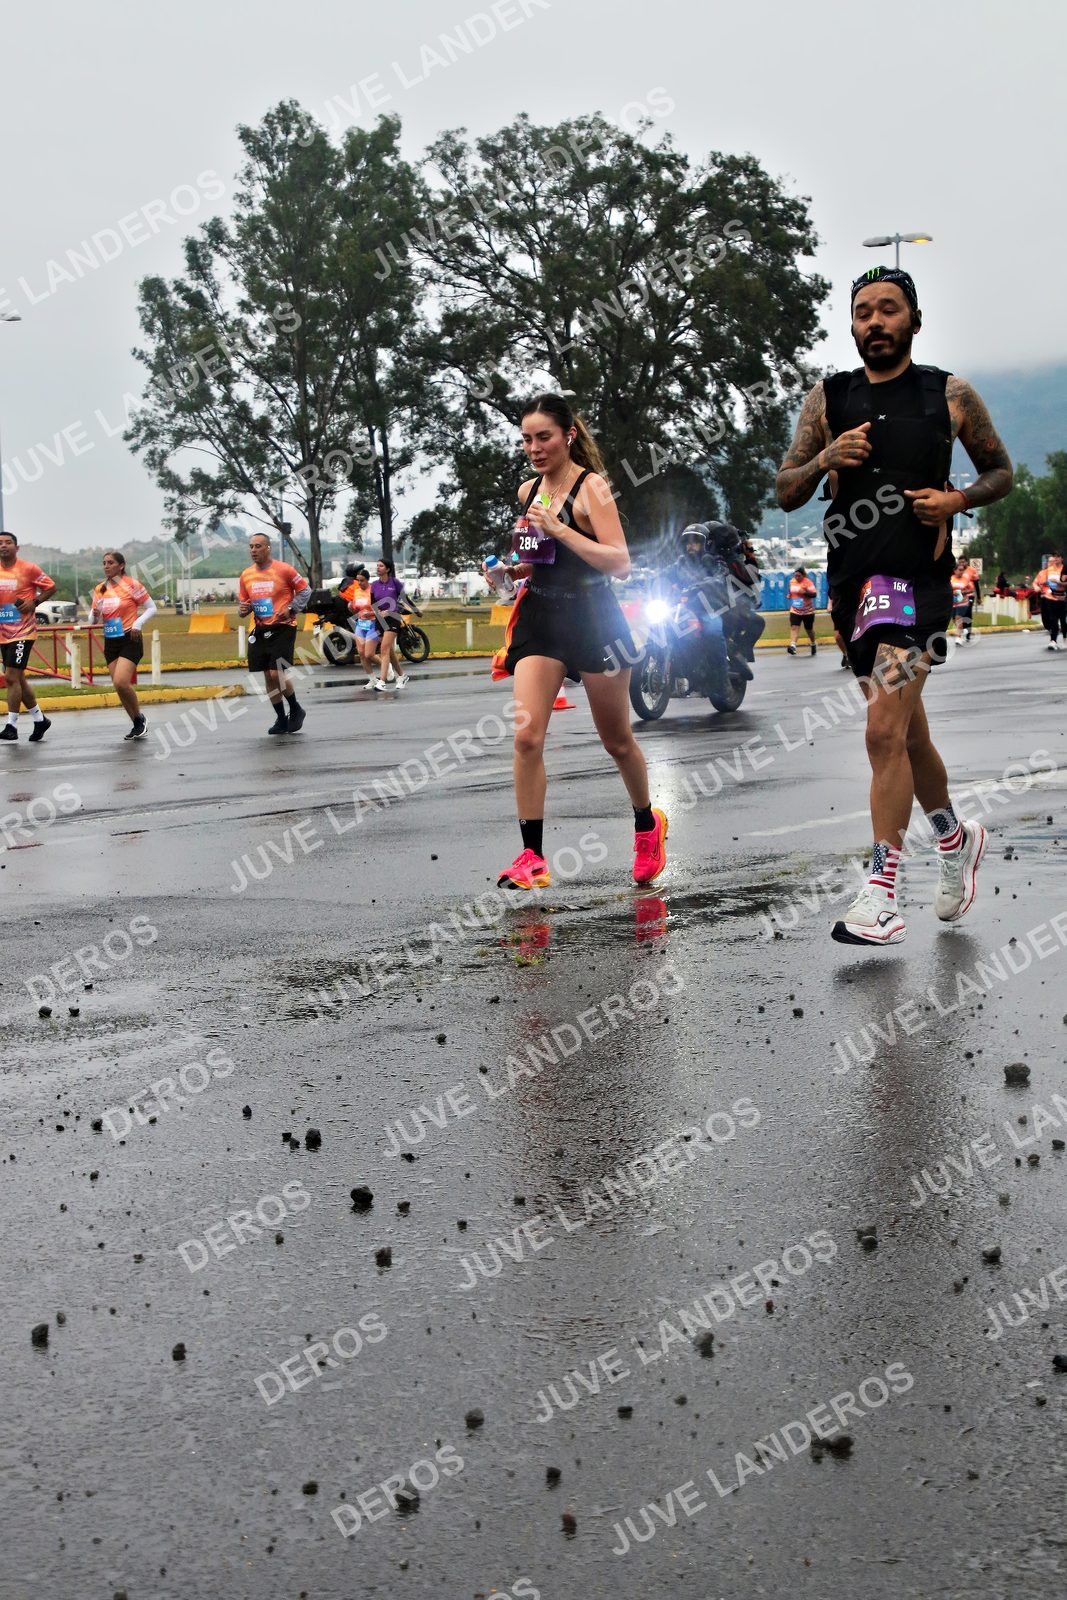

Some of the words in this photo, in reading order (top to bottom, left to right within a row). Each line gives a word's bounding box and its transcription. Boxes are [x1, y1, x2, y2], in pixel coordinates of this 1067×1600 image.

[519, 537, 539, 550] 284
[893, 581, 908, 593] 16K
[16, 640, 26, 664] adid
